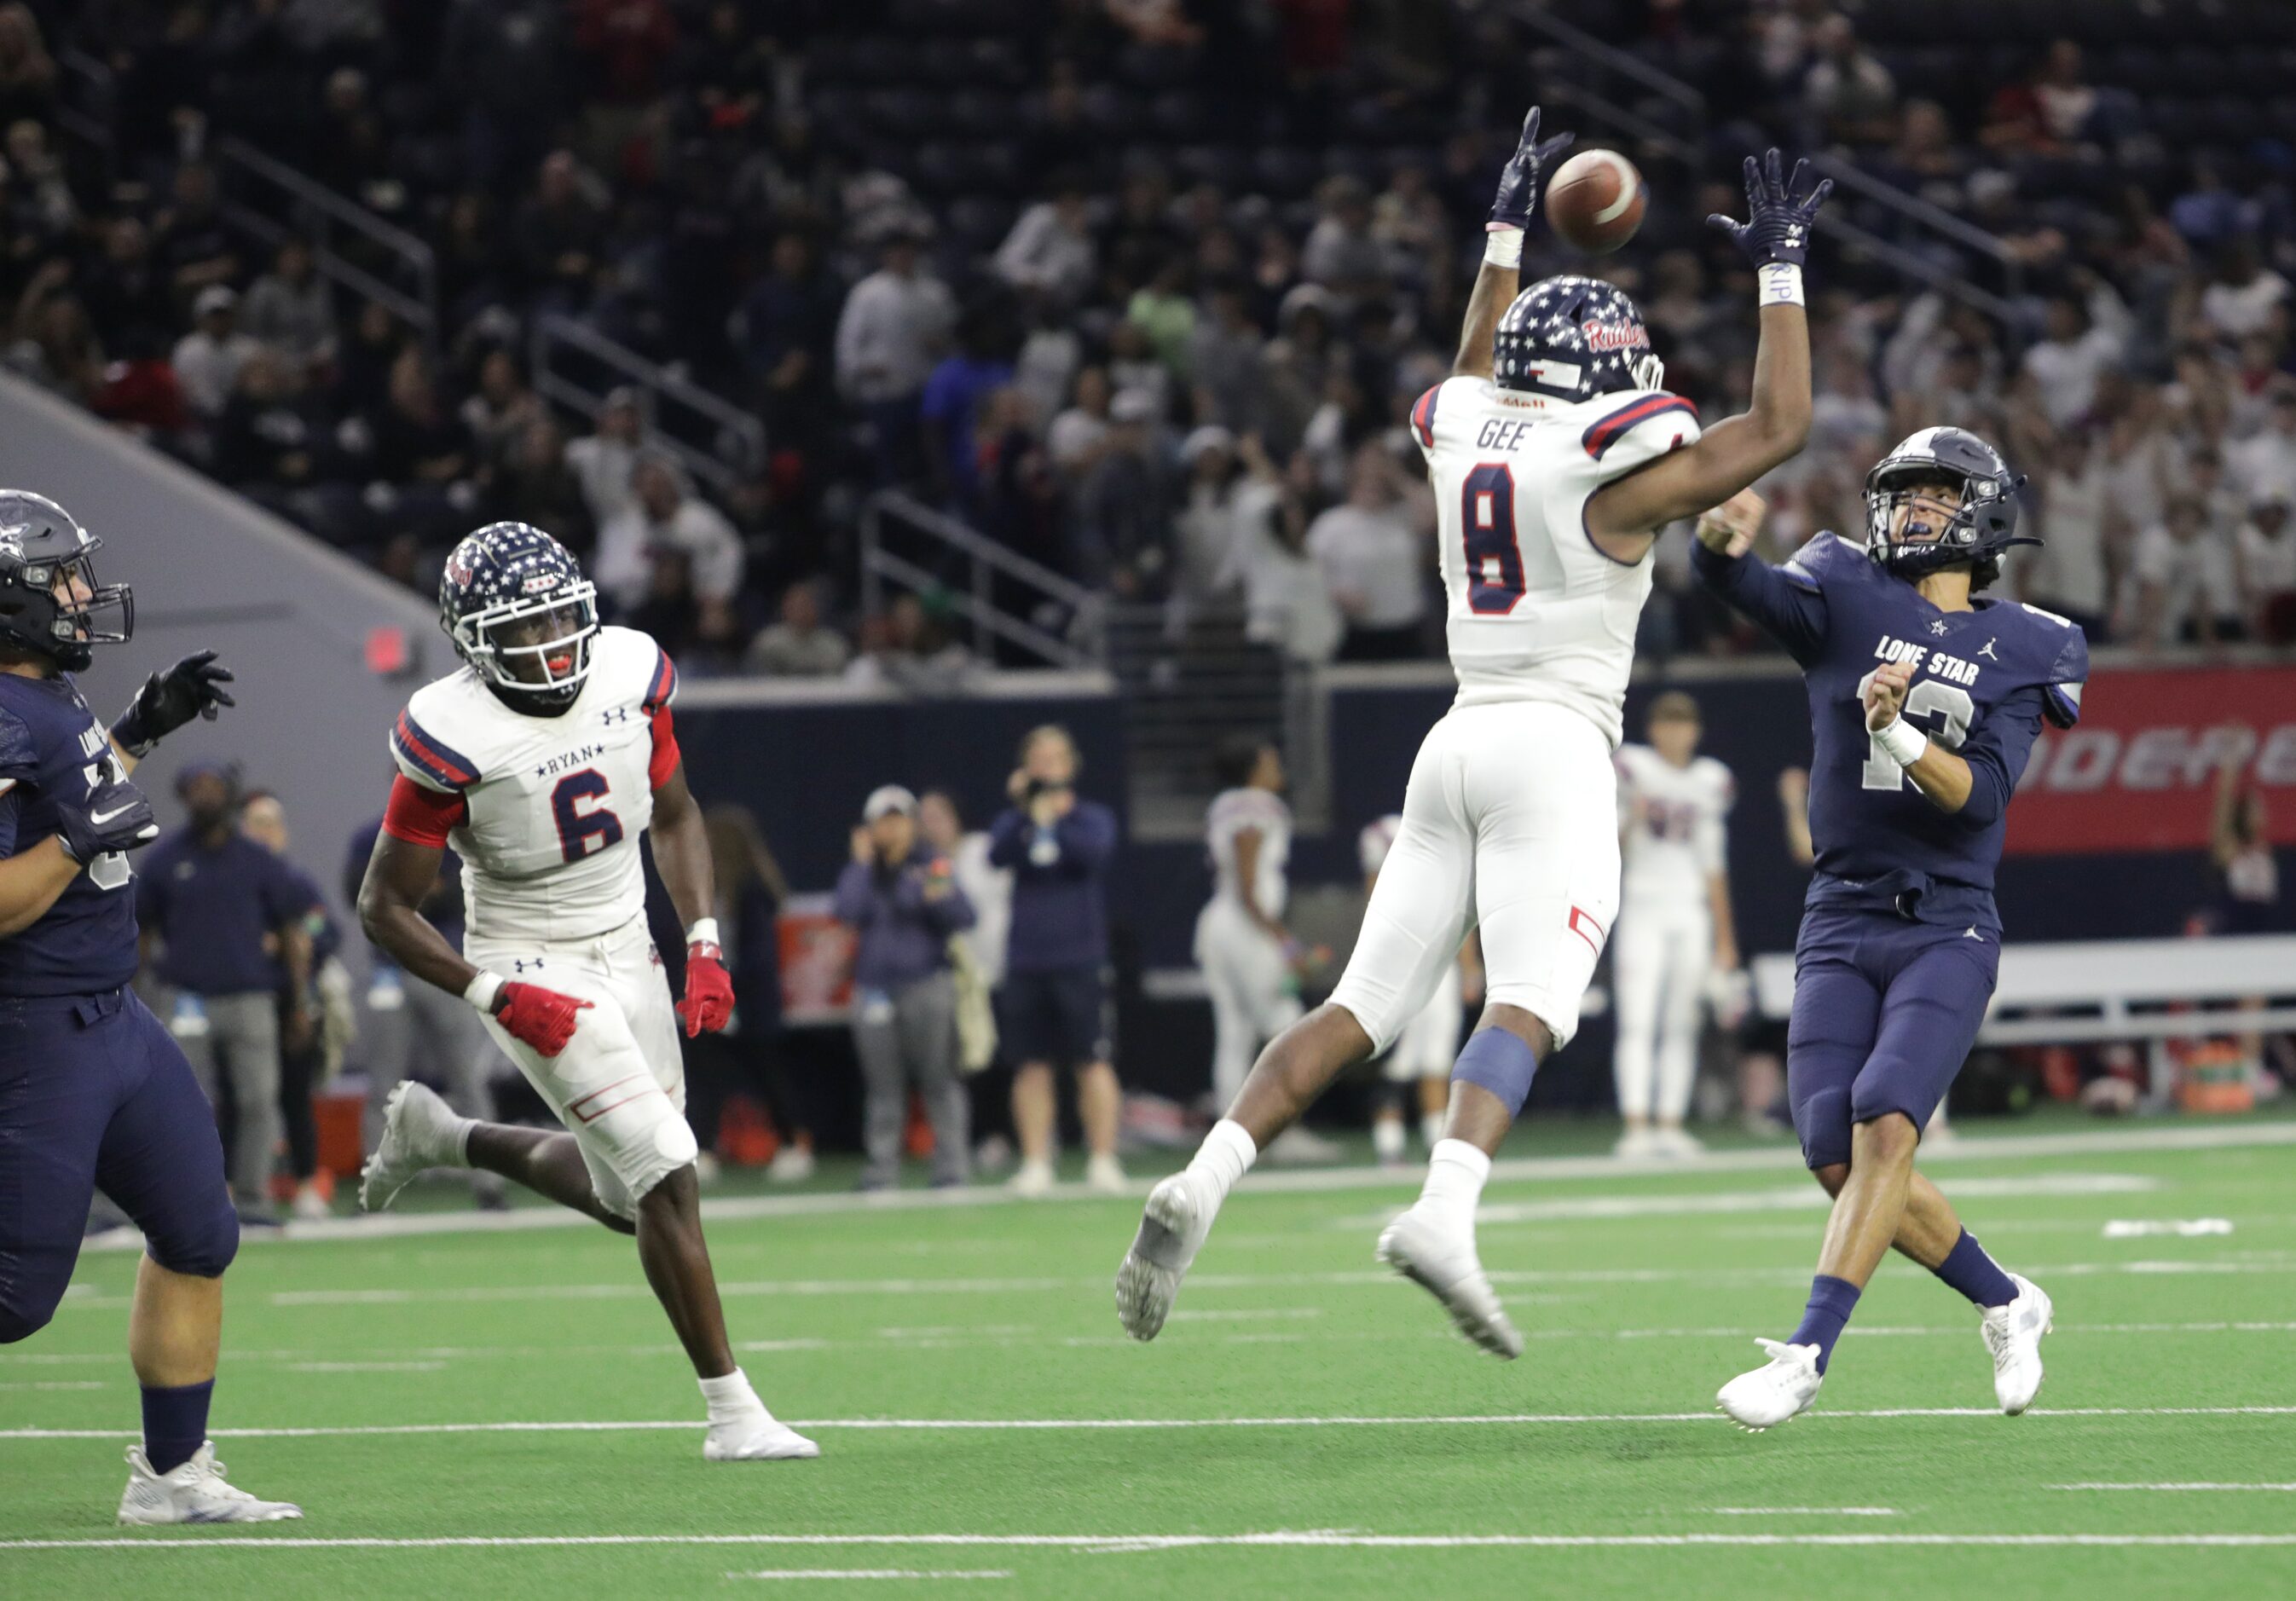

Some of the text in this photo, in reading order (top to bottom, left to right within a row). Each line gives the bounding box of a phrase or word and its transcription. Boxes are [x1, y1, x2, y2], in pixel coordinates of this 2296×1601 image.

[1477, 419, 1534, 451] GEE
[1461, 462, 1526, 615] 8
[1874, 635, 1981, 687] LONE STAR
[547, 745, 593, 774] RYAN
[550, 767, 623, 864] 6
